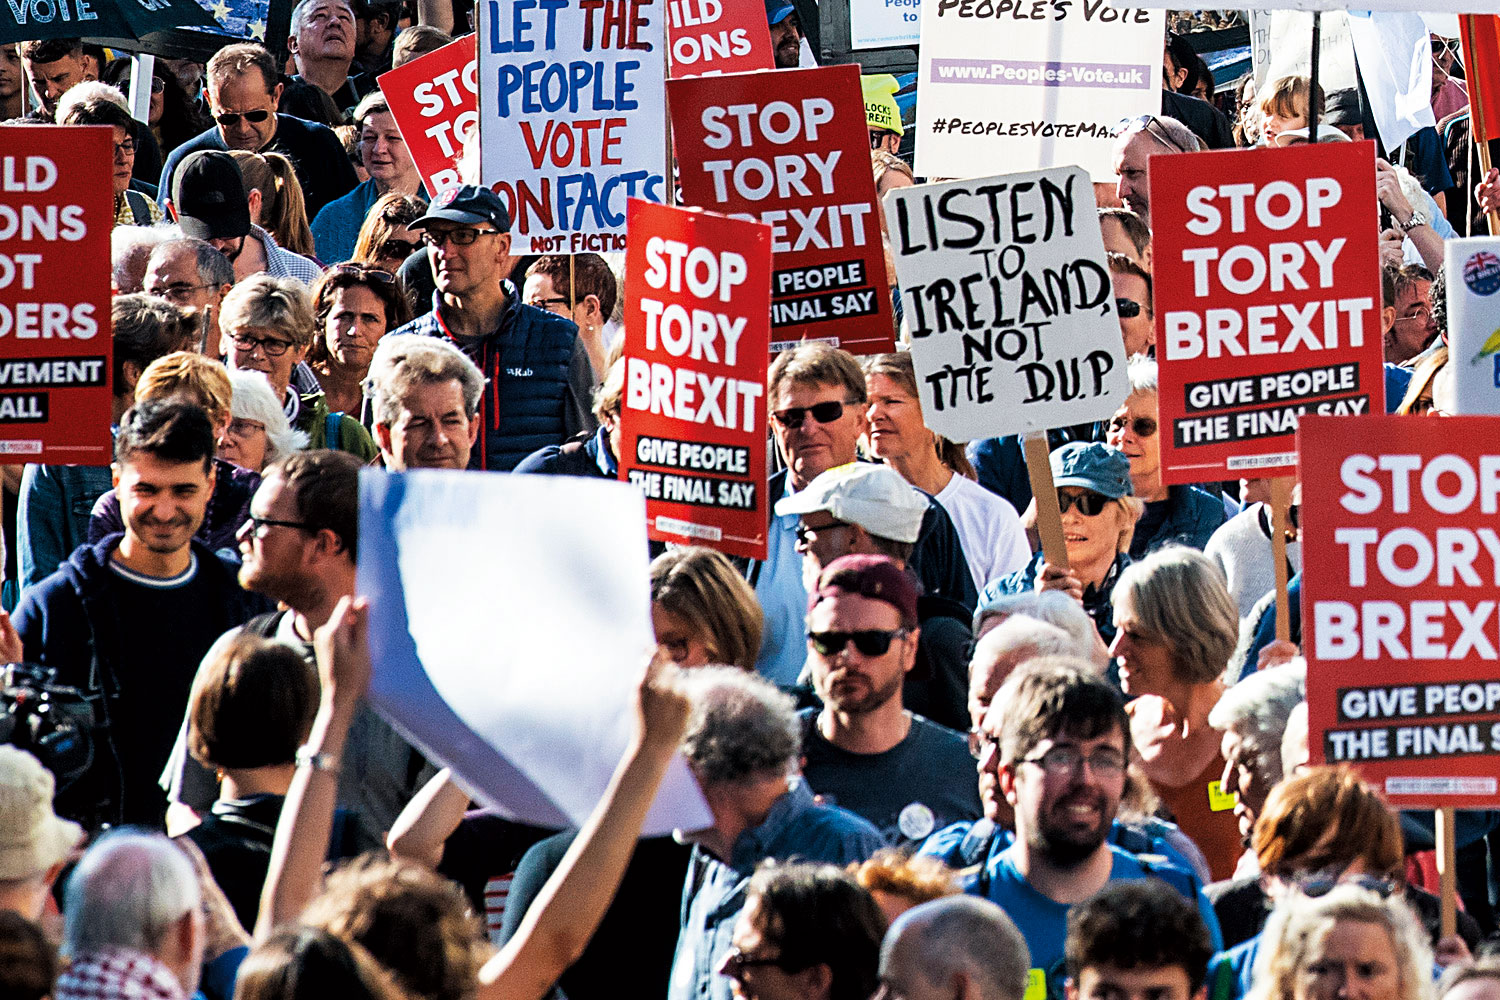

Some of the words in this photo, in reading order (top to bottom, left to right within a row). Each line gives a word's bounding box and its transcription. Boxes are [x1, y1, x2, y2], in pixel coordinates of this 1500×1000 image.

[489, 0, 568, 53] LET
[499, 60, 638, 117] PEOPLE
[938, 65, 1144, 85] www.Peoples-Vote.uk
[520, 118, 628, 169] VOTE
[896, 174, 1077, 257] LISTEN
[1185, 177, 1343, 235] STOP
[530, 234, 567, 254] NOT
[644, 235, 748, 302] STOP
[971, 244, 1026, 281] TO
[1182, 238, 1348, 297] TORY
[905, 258, 1112, 339] IRELAND,
[640, 299, 748, 367] TORY
[962, 322, 1052, 366] NOT
[1165, 297, 1373, 361] BREXIT
[627, 359, 763, 432] BREXIT
[926, 364, 991, 412] THE
[1342, 689, 1416, 720] GIVE
